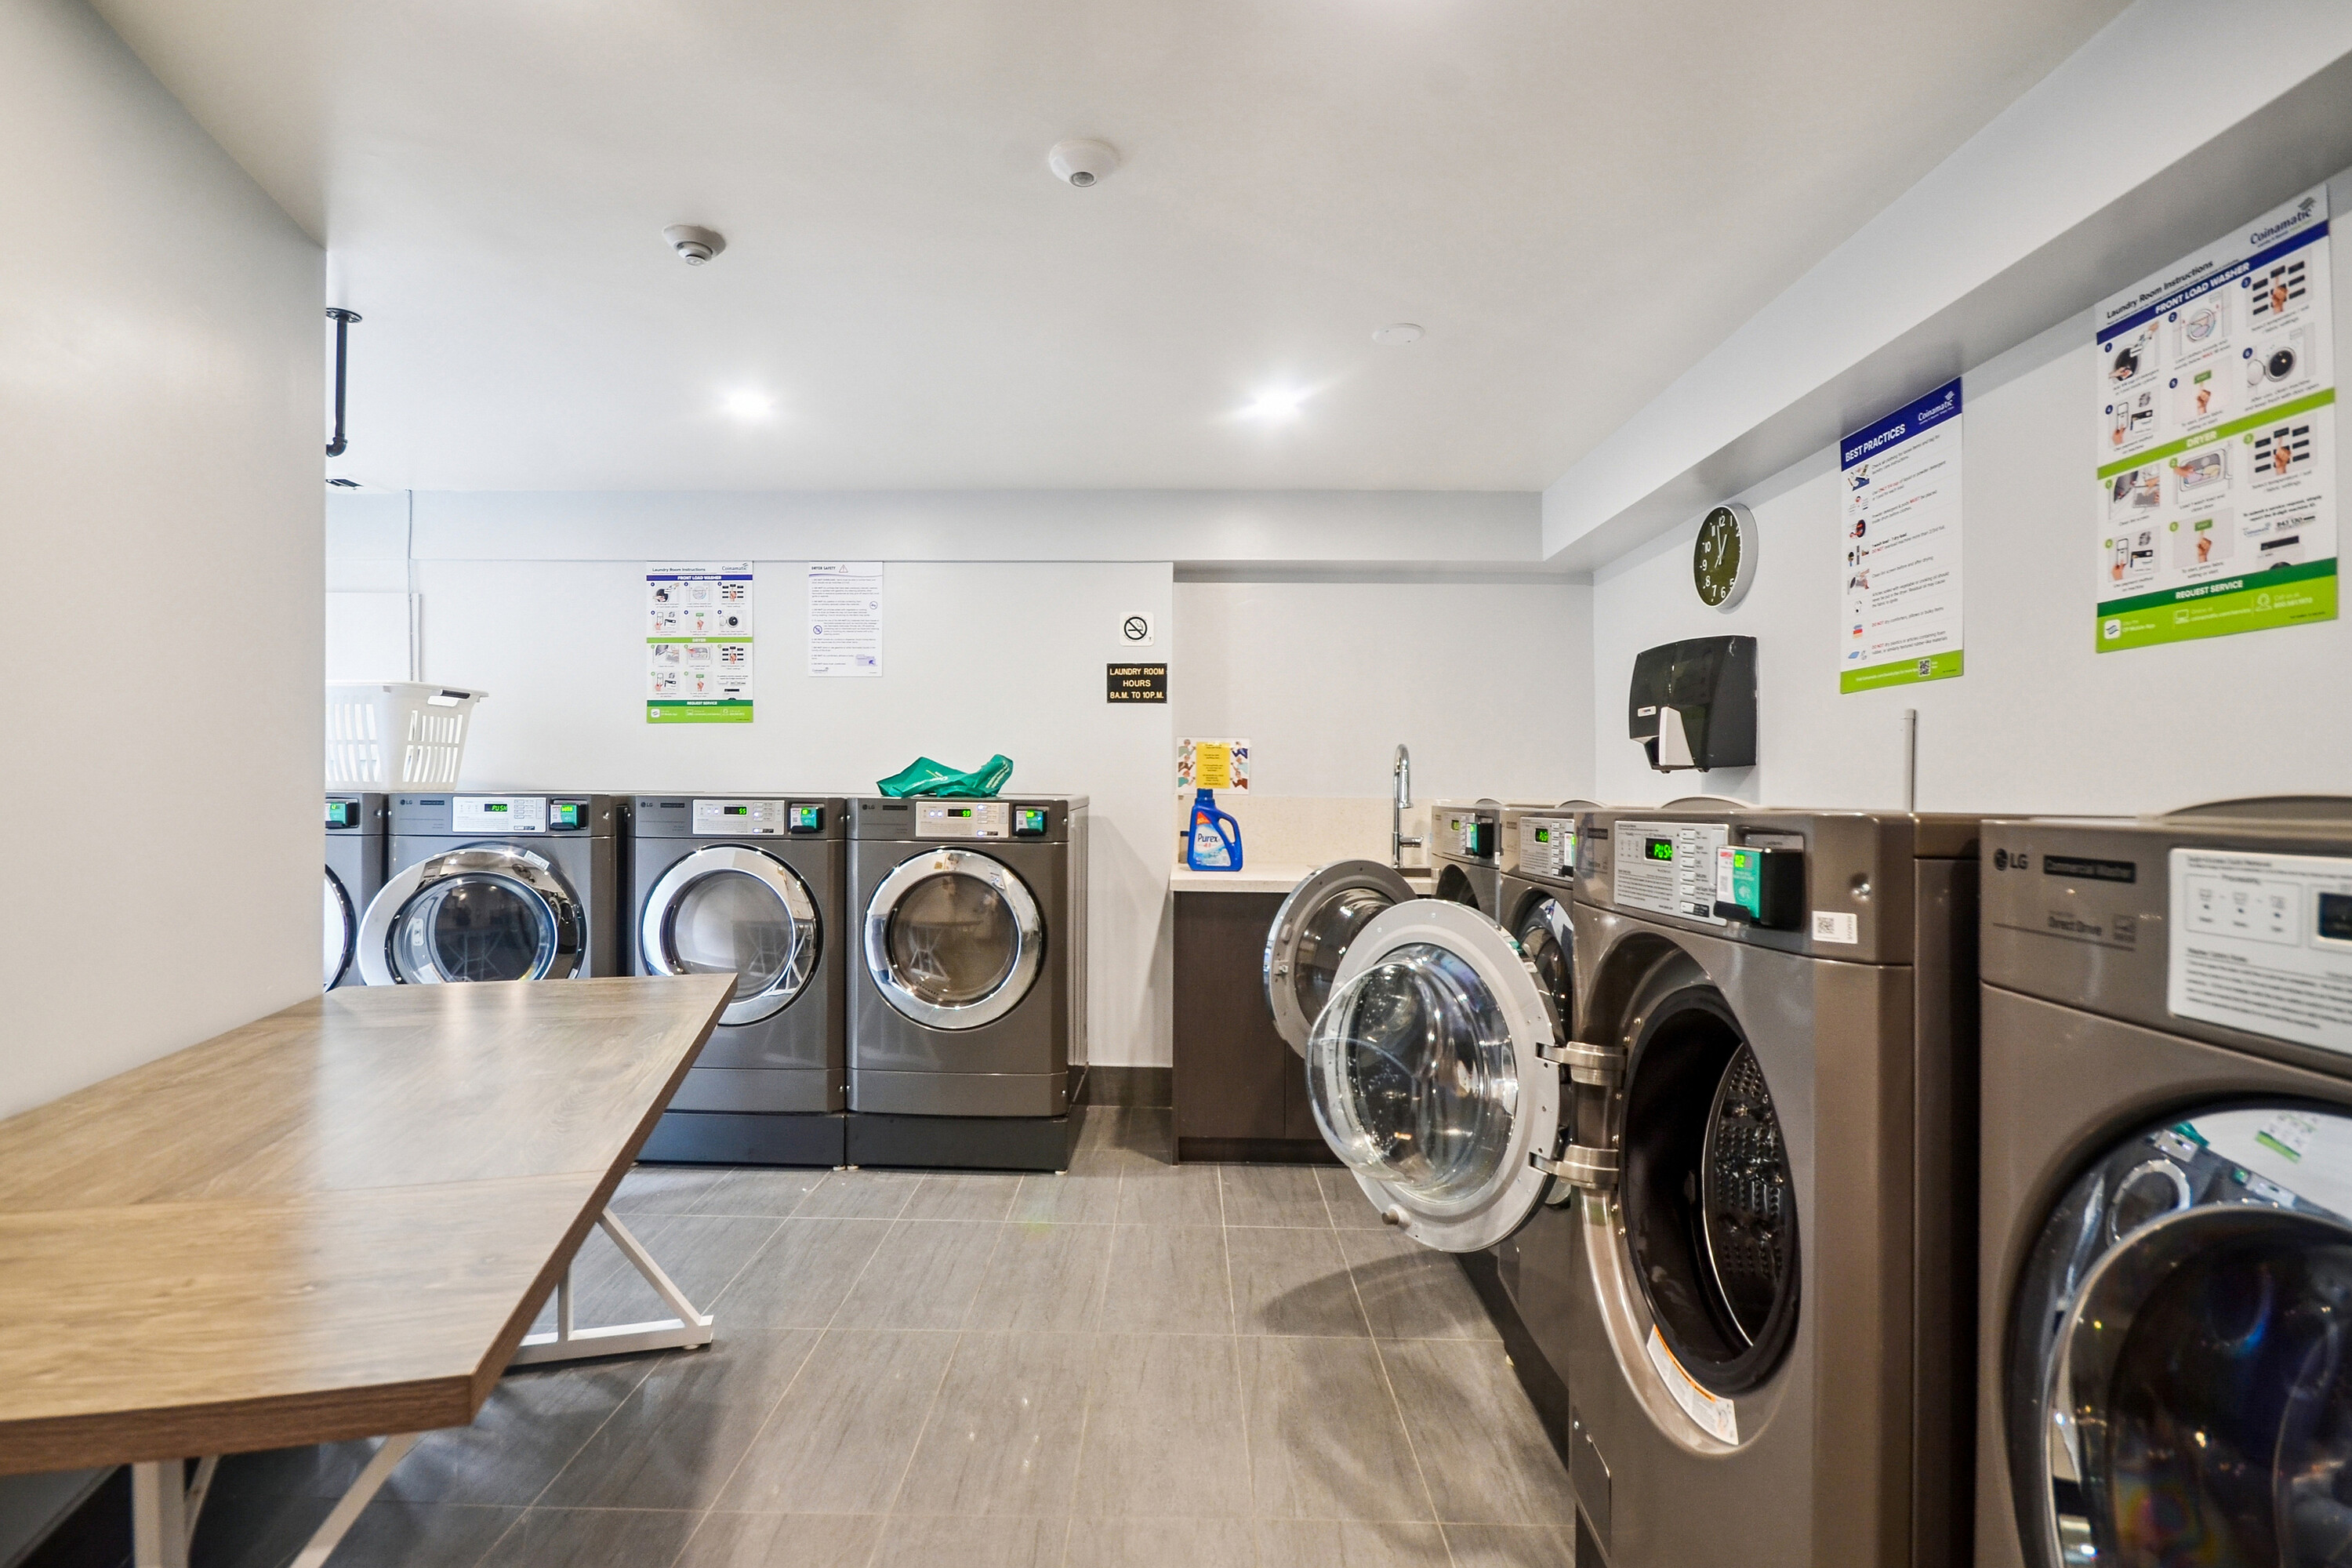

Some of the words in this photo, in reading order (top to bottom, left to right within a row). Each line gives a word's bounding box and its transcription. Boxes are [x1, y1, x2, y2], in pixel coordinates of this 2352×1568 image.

[2250, 209, 2311, 245] Coinamatic
[2107, 300, 2137, 319] Laundry
[2140, 286, 2162, 303] Room
[2165, 261, 2212, 290] Instructions
[2155, 295, 2183, 315] FRONT
[2185, 283, 2209, 300] LOAD
[2210, 262, 2249, 288] WASHER
[1918, 399, 1953, 421] Coinamatic
[1846, 445, 1862, 462] BEST
[1864, 424, 1906, 453] PRACTICES
[2187, 431, 2217, 448] DRYER
[1719, 515, 1726, 527] 12
[1711, 524, 1716, 537] 11
[1736, 526, 1740, 537] 2
[1704, 541, 1711, 554] 10
[1702, 559, 1708, 571] 9
[1705, 575, 1711, 587] 8
[1730, 578, 1735, 588] 5
[1711, 584, 1717, 597] 7
[1721, 586, 1726, 598] 6
[2176, 587, 2209, 599] REQUEST
[2210, 580, 2243, 593] SERVICE
[1198, 833, 1218, 843] Purex
